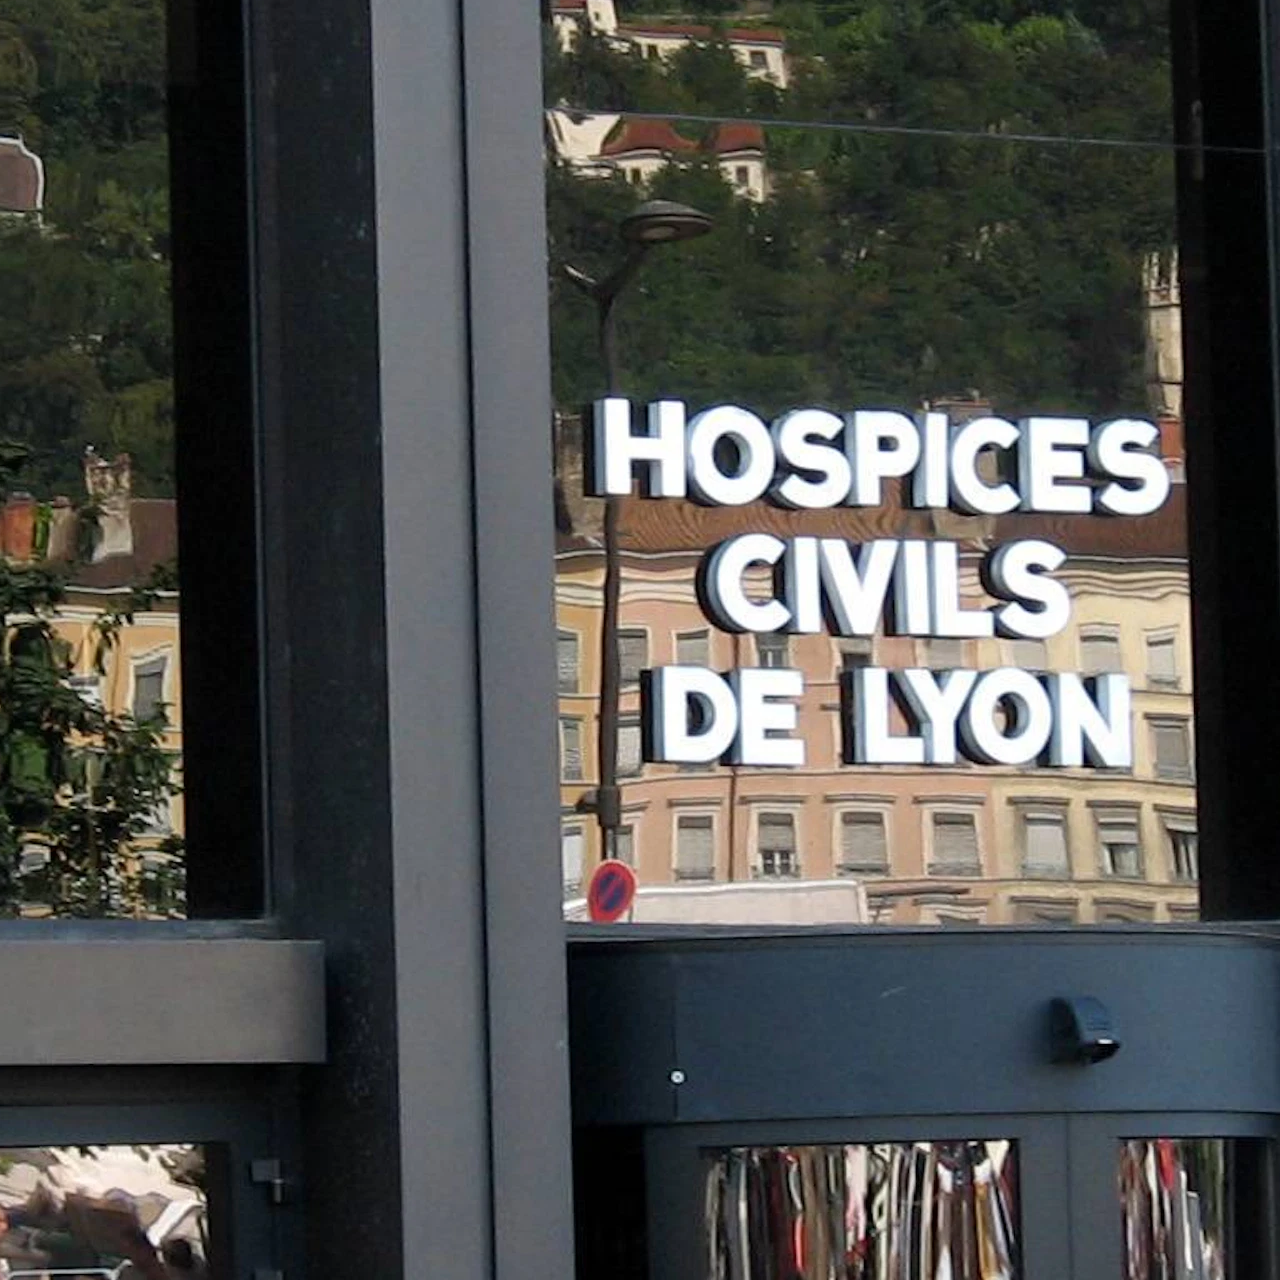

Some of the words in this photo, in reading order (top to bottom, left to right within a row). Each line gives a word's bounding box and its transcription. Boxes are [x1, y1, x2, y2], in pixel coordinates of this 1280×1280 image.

[588, 396, 1172, 516] HOSPICES
[702, 533, 1073, 639] CIVILS
[647, 665, 806, 767] DE
[848, 665, 1132, 768] LYON
